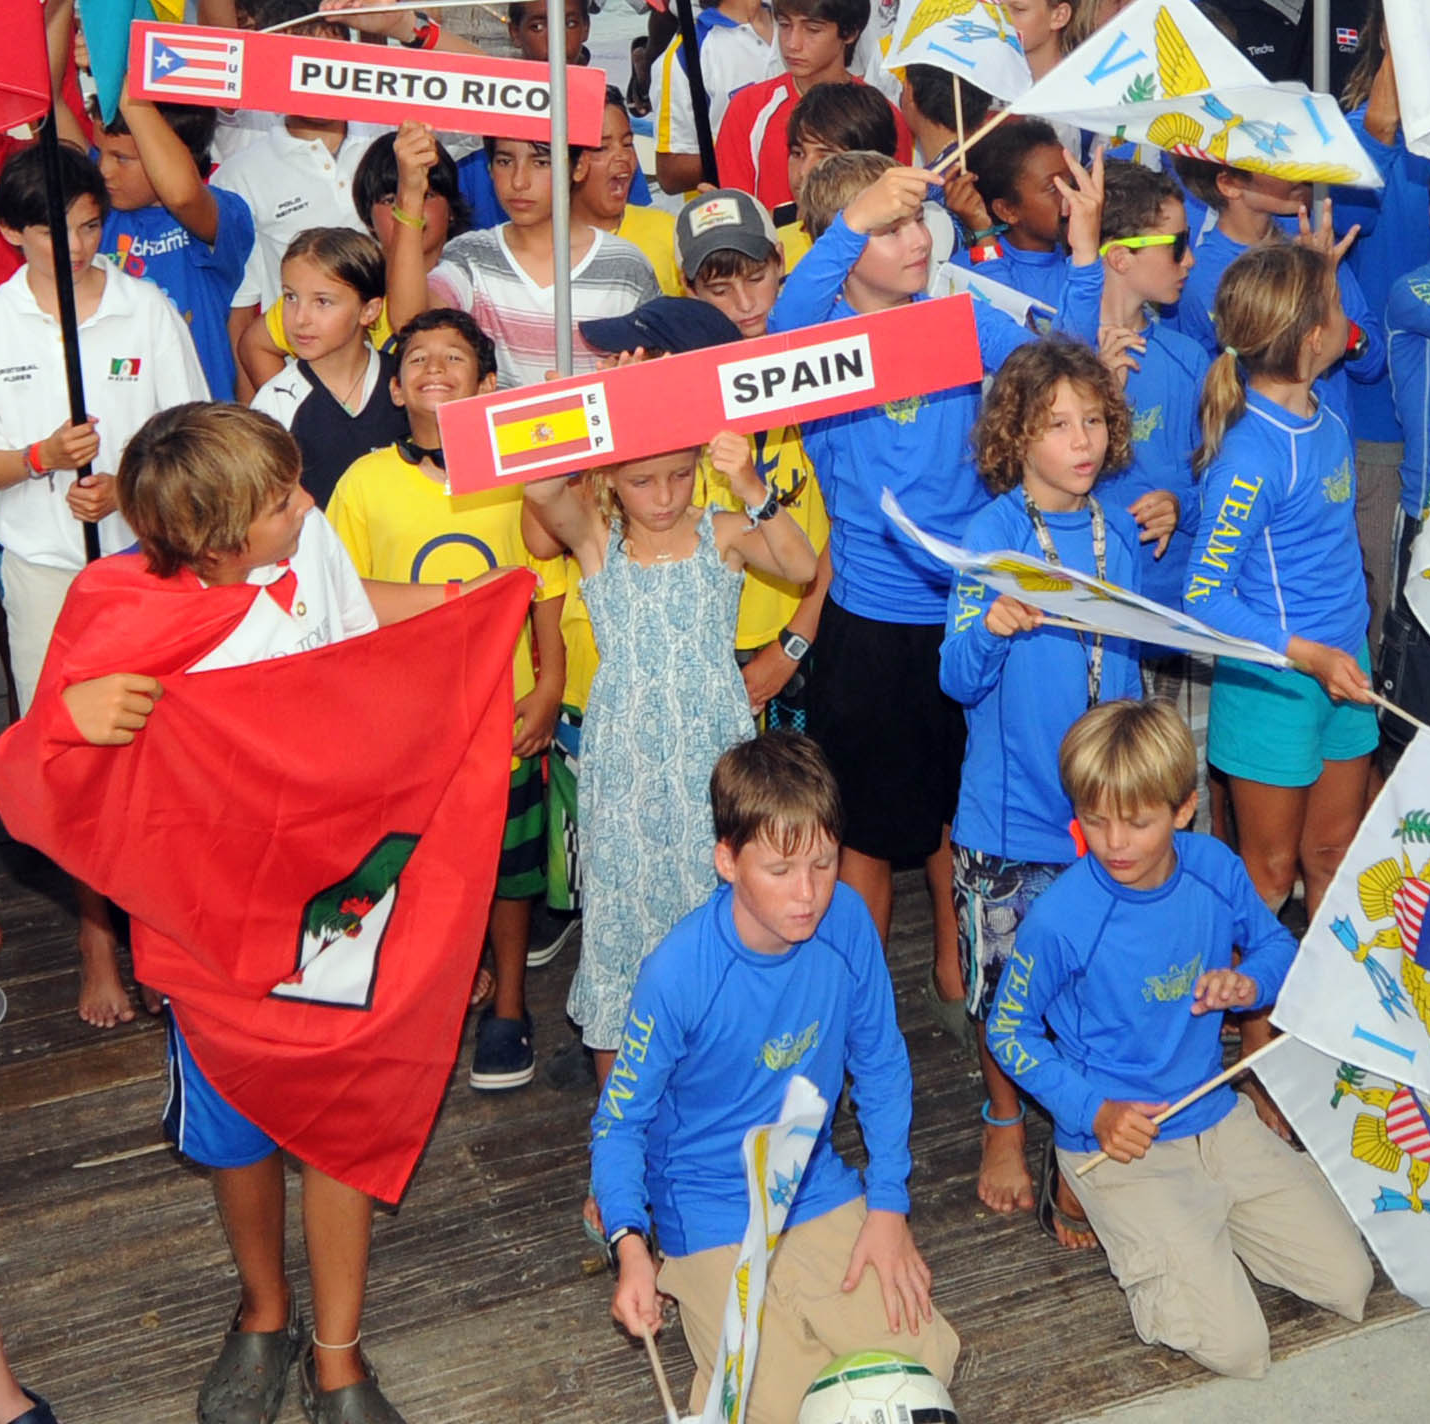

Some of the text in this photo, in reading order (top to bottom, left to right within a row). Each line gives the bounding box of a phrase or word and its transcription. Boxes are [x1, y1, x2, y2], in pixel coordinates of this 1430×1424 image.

[301, 61, 551, 113] PUERTO RICO
[1084, 31, 1148, 86] V
[733, 348, 864, 405] SPAIN
[586, 391, 606, 449] ESP
[1200, 474, 1265, 573] TEAM
[604, 1007, 656, 1121] TEAM
